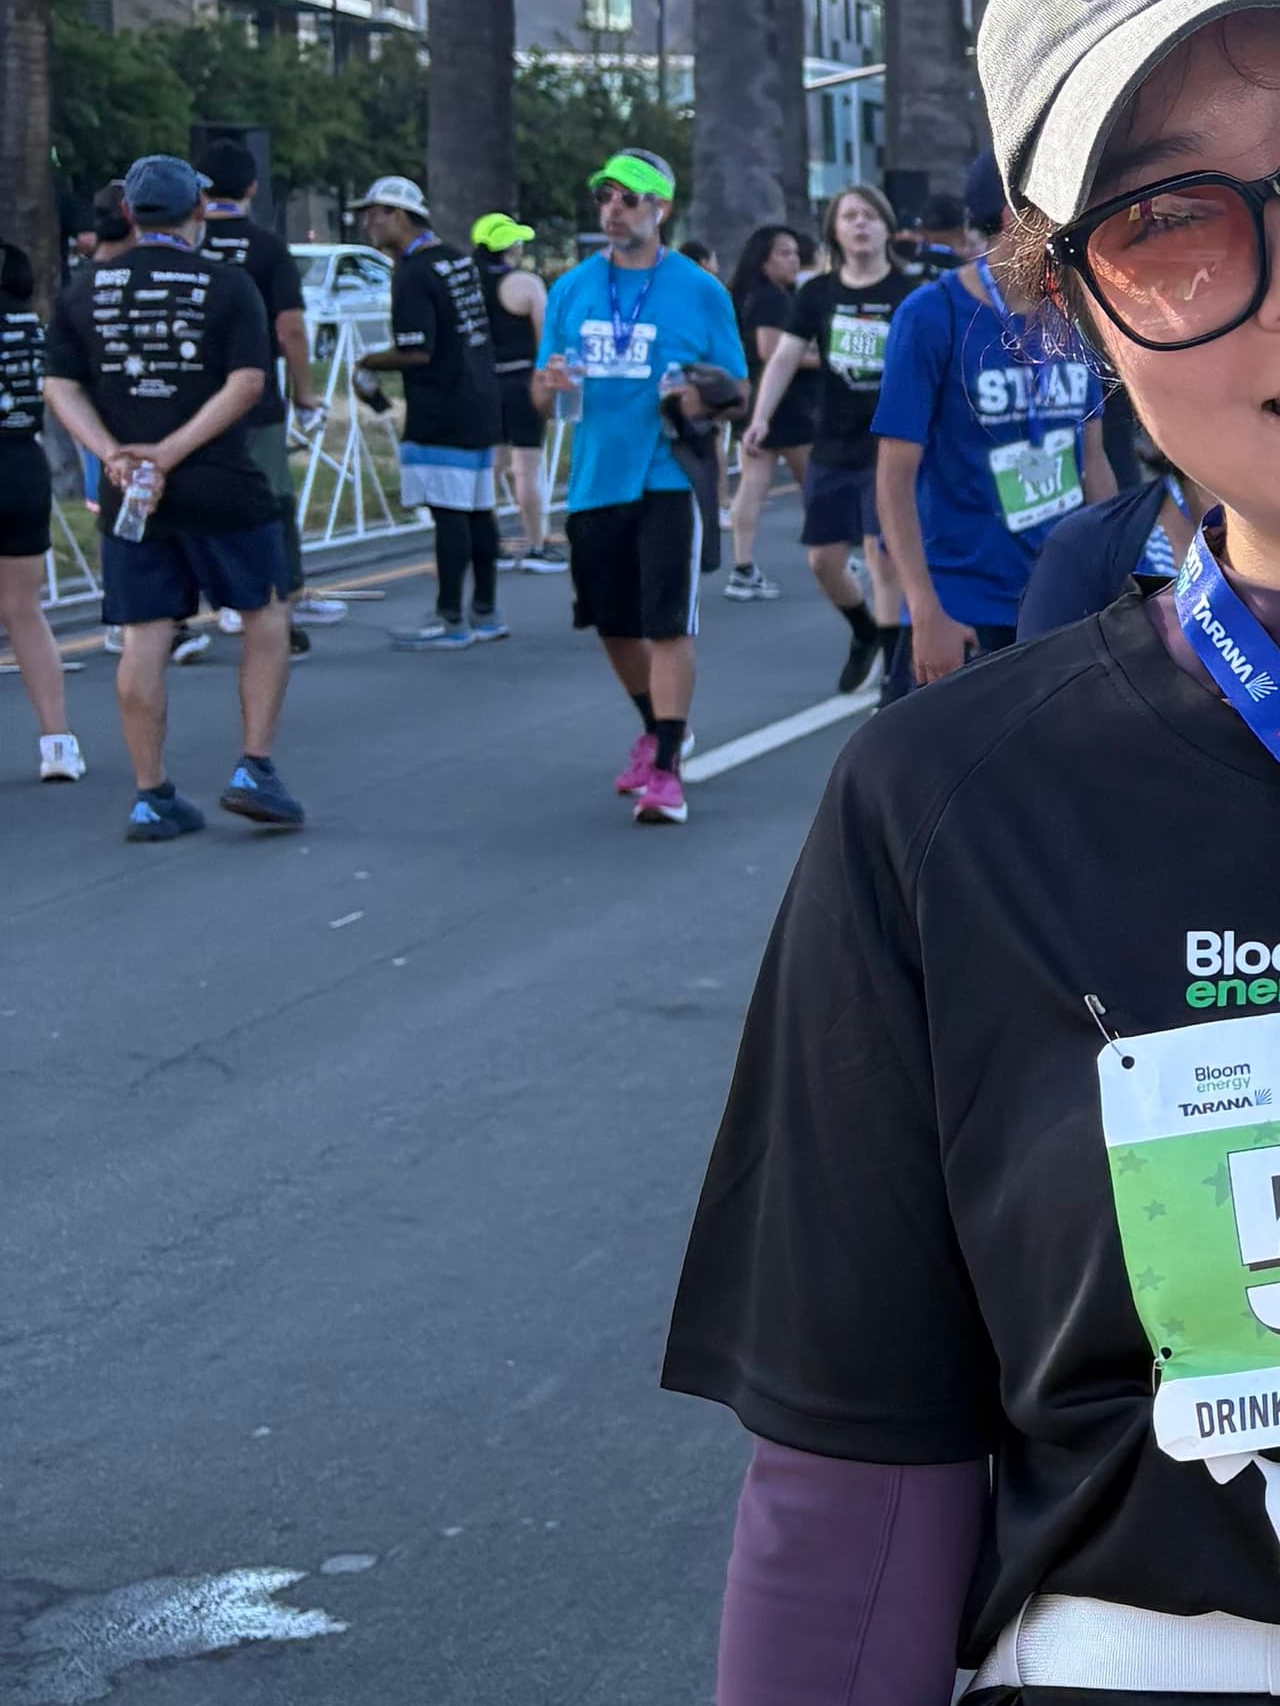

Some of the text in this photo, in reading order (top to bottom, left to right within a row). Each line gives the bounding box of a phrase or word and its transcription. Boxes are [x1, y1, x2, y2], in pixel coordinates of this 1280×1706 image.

[1190, 594, 1254, 684] TARANA
[1195, 1063, 1251, 1082] Bloom
[1196, 1076, 1251, 1093] energy
[1178, 1096, 1254, 1117] TARANA
